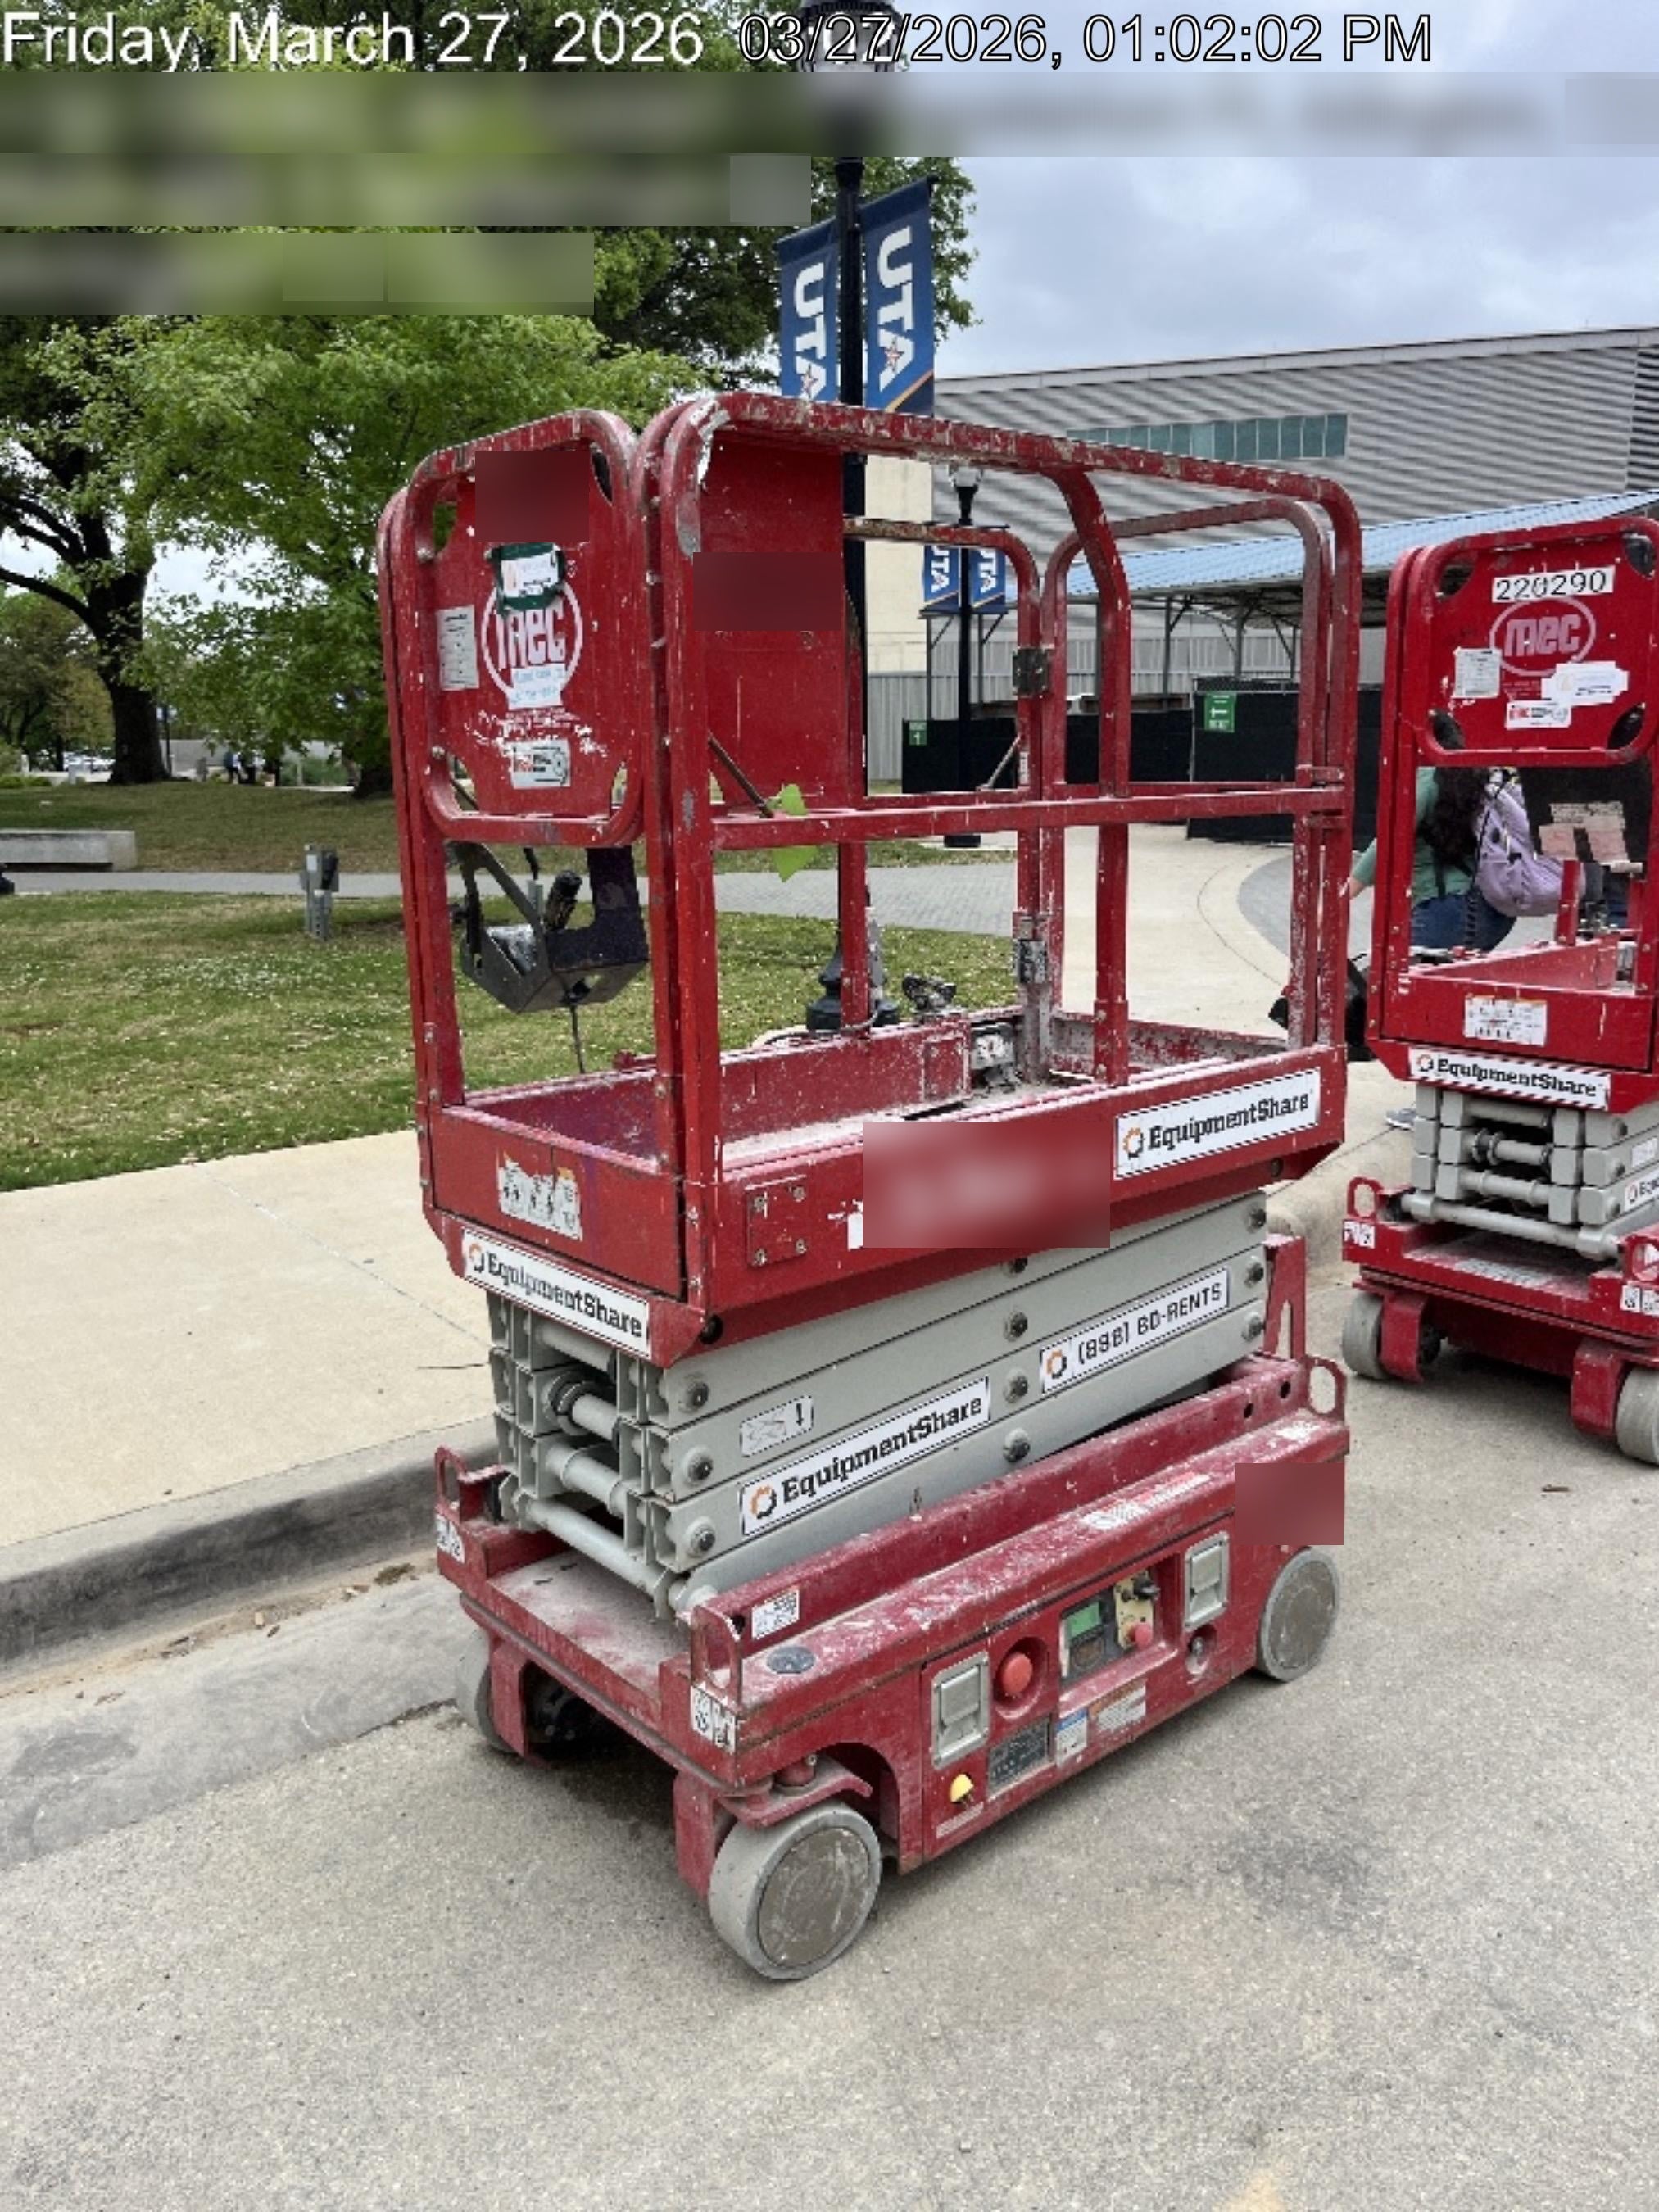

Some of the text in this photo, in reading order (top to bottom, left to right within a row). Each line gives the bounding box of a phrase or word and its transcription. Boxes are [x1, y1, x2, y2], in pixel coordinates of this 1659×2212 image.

[794, 262, 827, 401] UTA
[877, 225, 913, 392] UTA
[1496, 570, 1607, 601] 220290
[1437, 1058, 1597, 1097] EquipmentShare
[1148, 1093, 1309, 1151] EquipmentShare
[487, 1252, 643, 1339] EquipmentShare
[781, 1397, 983, 1504] EquipmentShare
